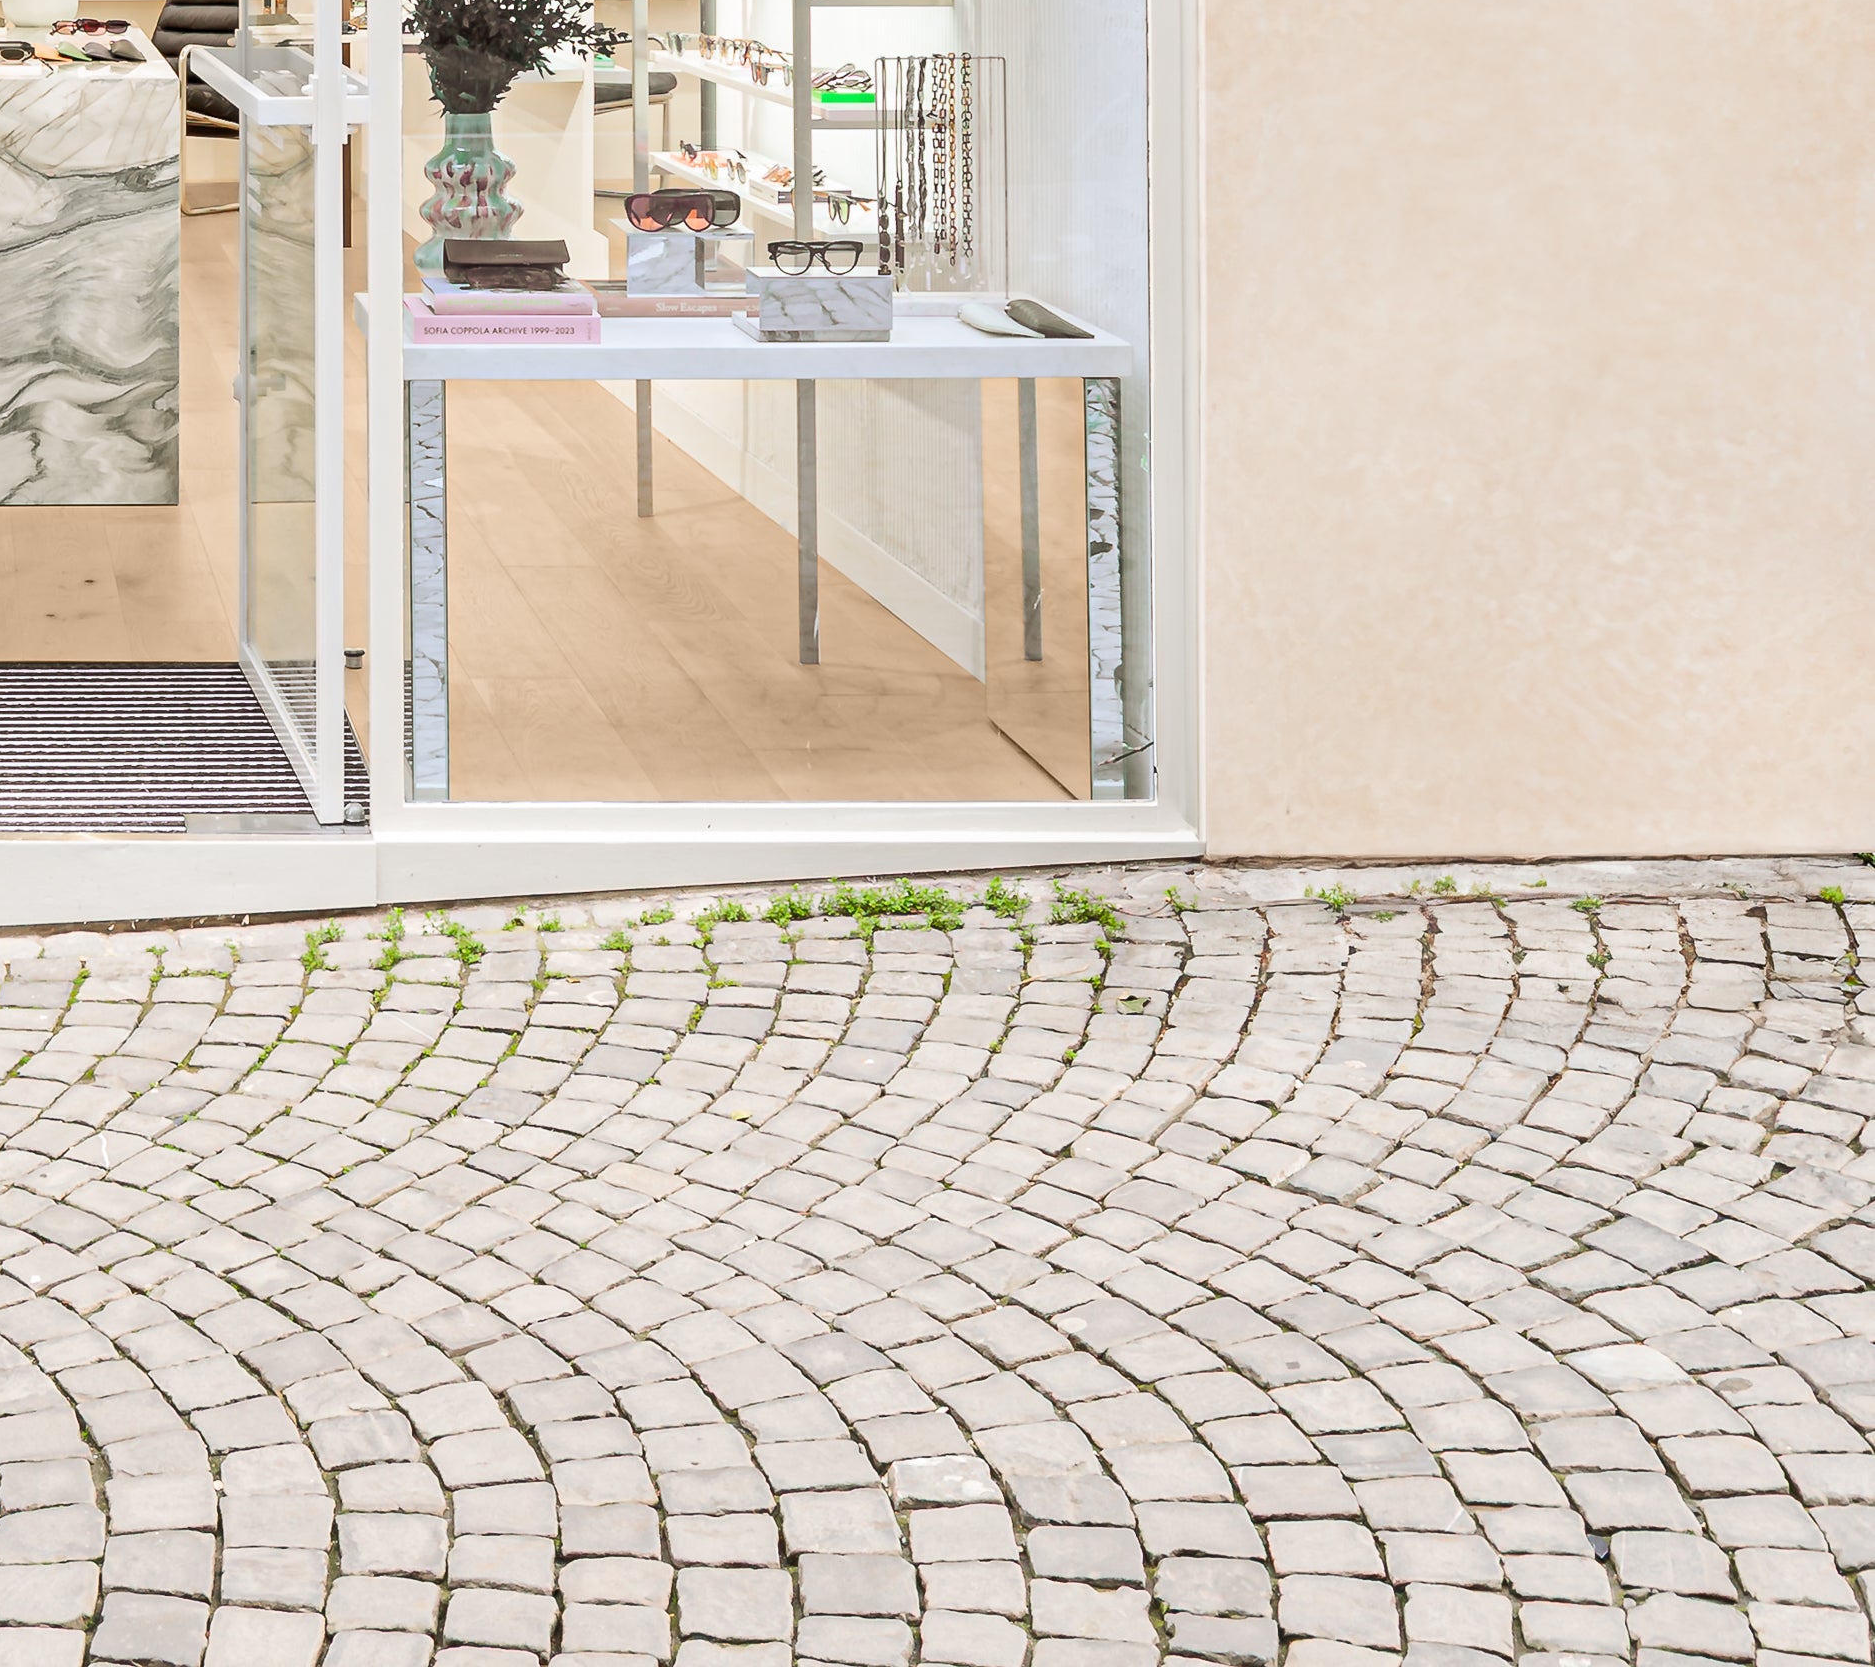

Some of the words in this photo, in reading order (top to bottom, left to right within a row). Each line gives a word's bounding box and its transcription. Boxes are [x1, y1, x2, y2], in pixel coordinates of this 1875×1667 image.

[423, 326, 449, 336] SOFIA
[450, 326, 490, 336] COPPOLA
[492, 326, 527, 336] ARCHIVE
